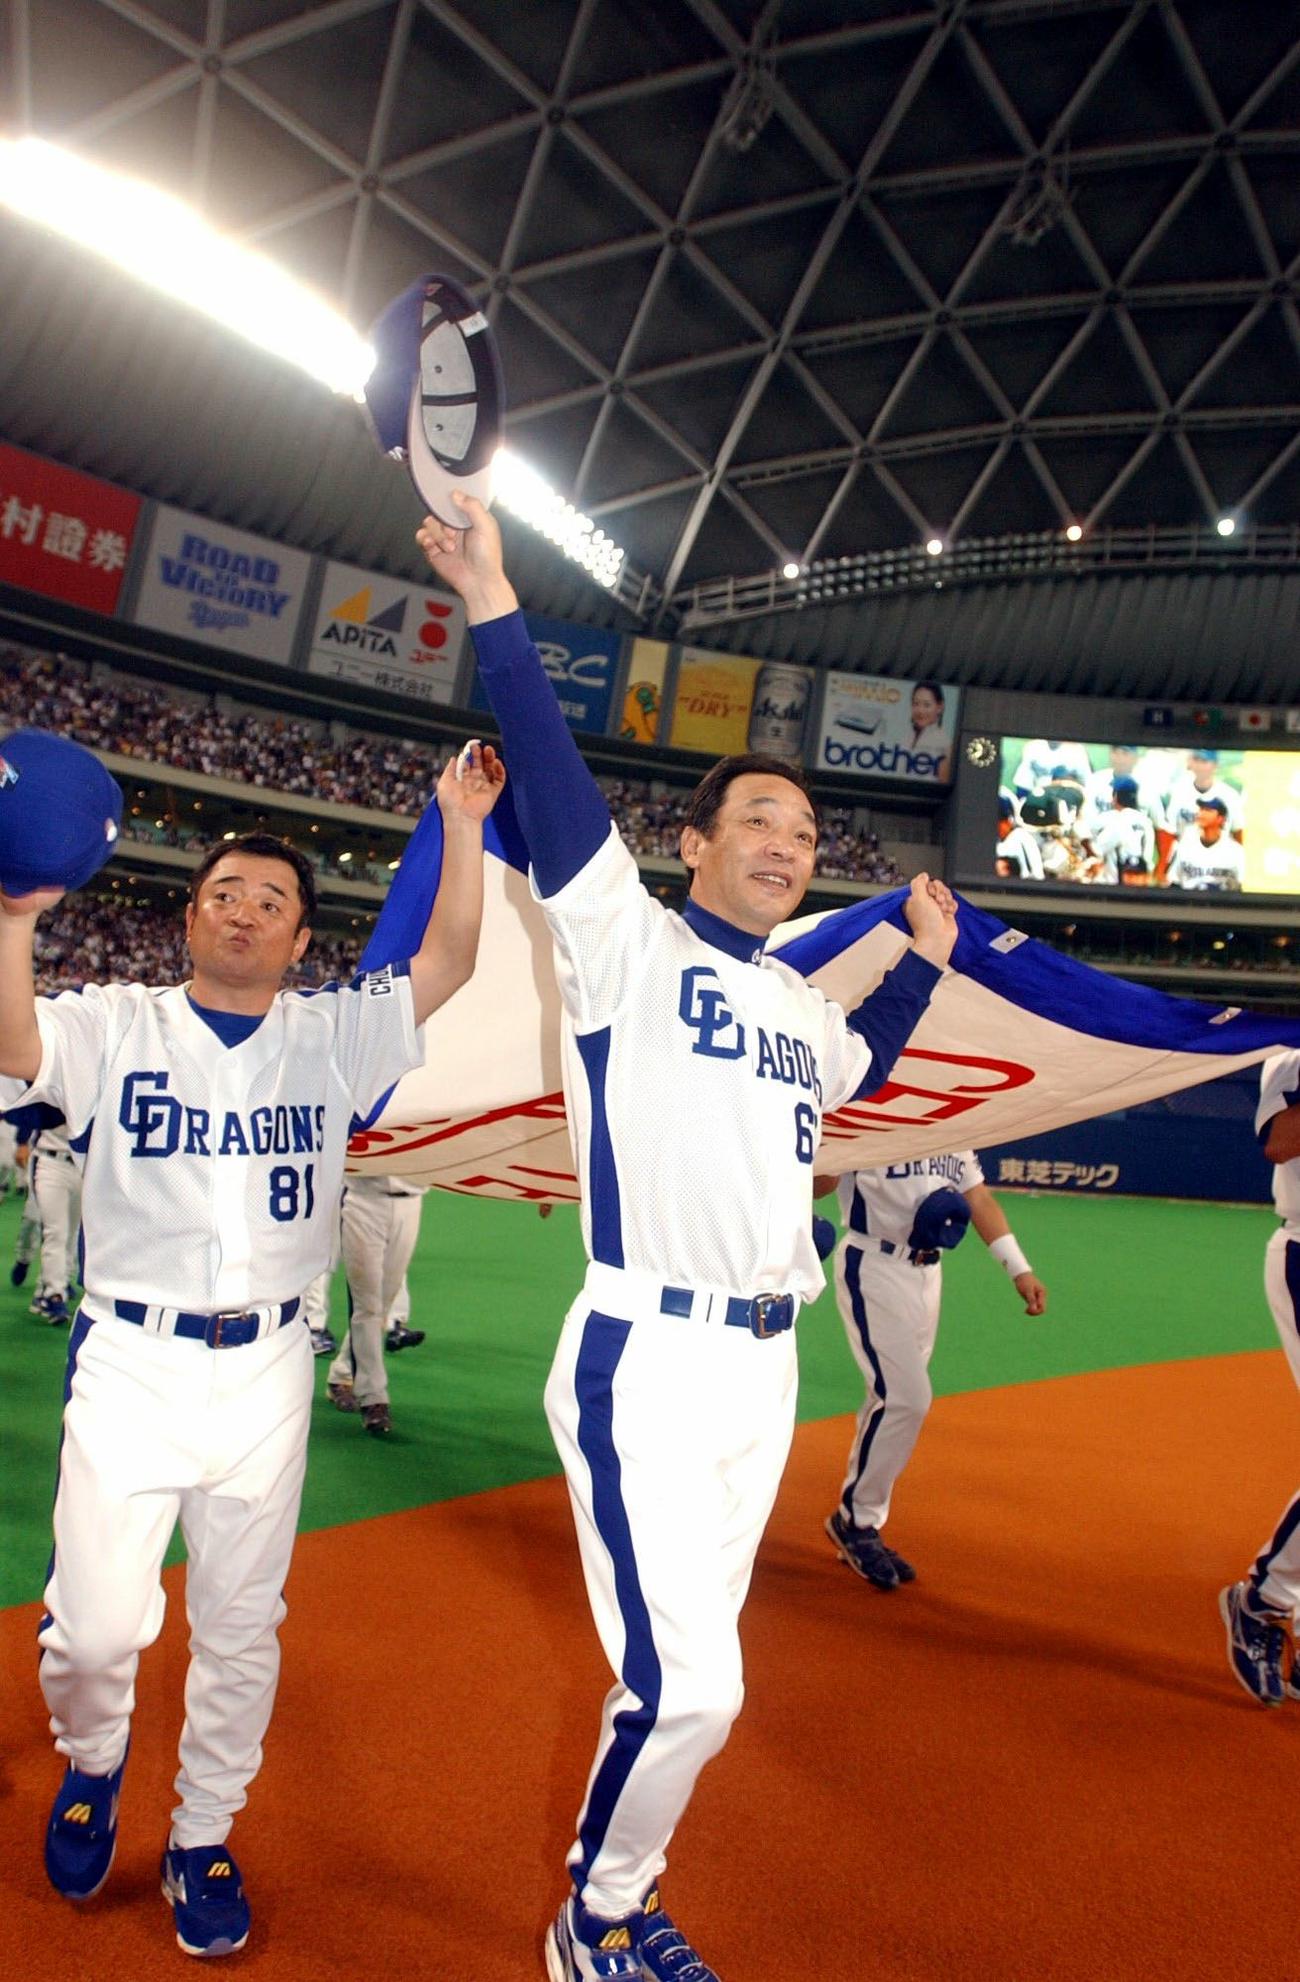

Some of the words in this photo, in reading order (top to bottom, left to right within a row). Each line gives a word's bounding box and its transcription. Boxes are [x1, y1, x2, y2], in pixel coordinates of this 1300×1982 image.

[181, 533, 280, 585] ROAD
[160, 556, 289, 618] VICTORY
[534, 641, 608, 689] BC
[824, 736, 947, 777] brother
[794, 1101, 819, 1165] 6
[268, 1163, 314, 1222] 81
[1000, 1157, 1120, 1189] 東芝テック
